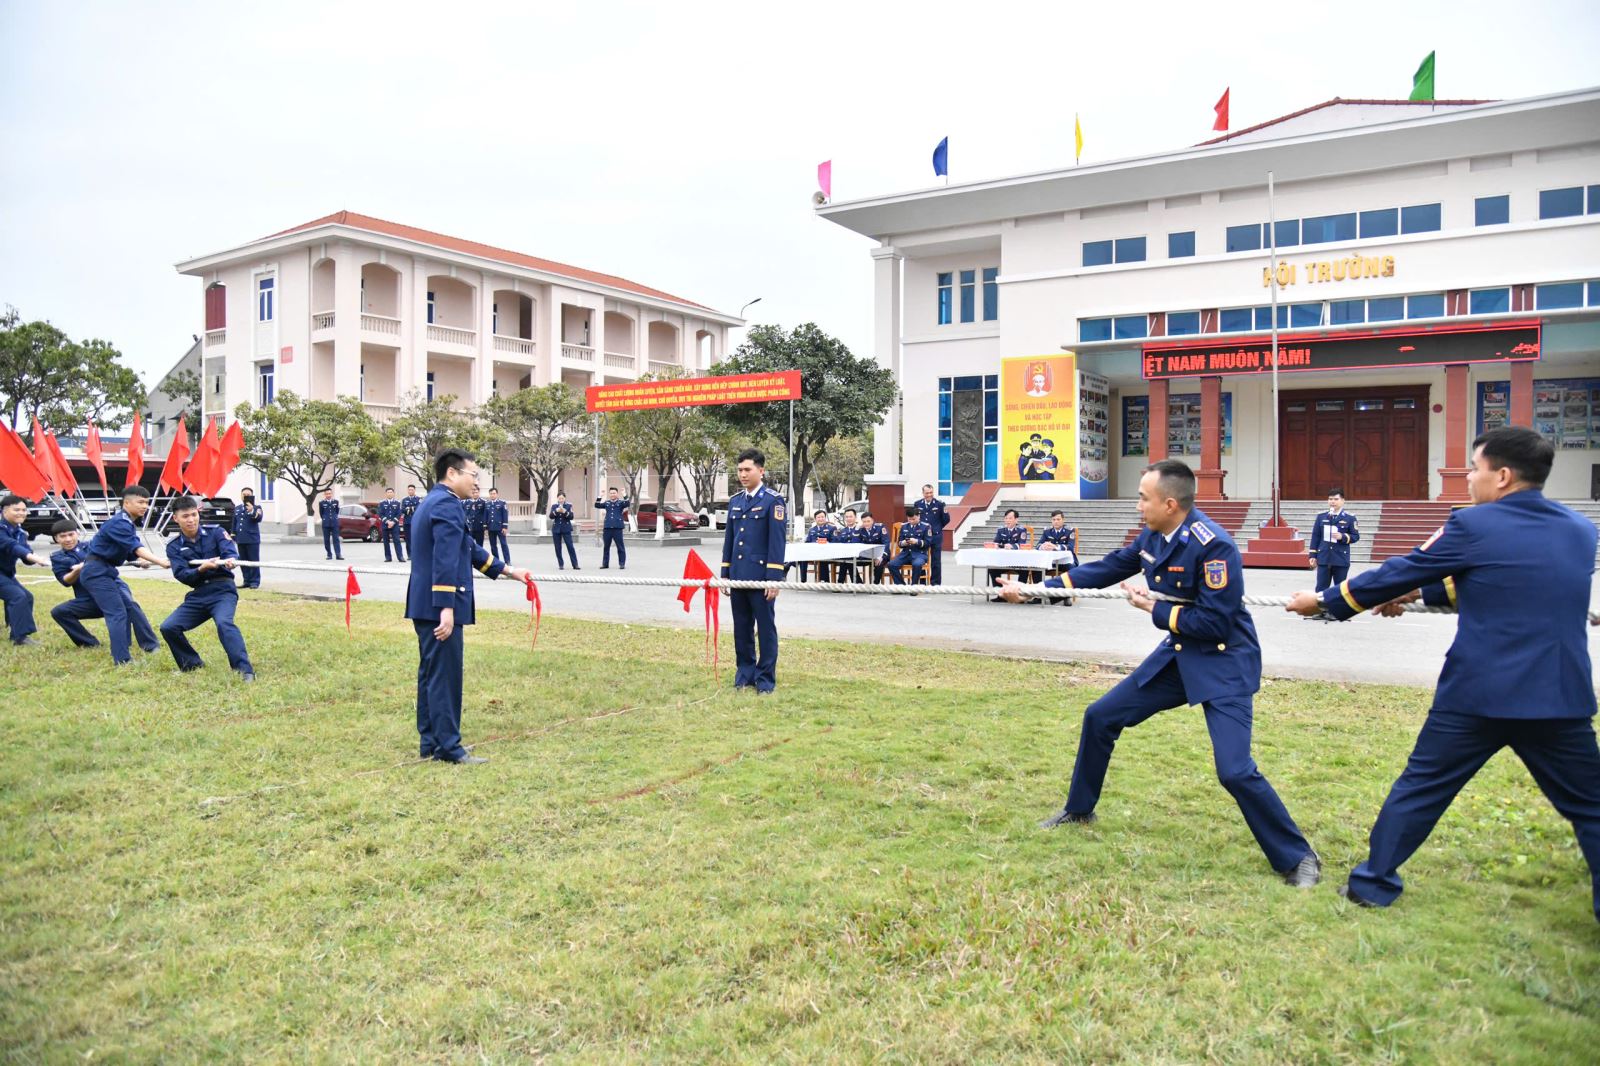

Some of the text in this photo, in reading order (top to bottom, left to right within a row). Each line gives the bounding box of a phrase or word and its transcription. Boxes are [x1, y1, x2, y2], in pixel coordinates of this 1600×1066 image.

[1305, 252, 1394, 284] TRƯỜNG
[1168, 355, 1206, 372] NAM
[1210, 350, 1260, 369] MUÔN
